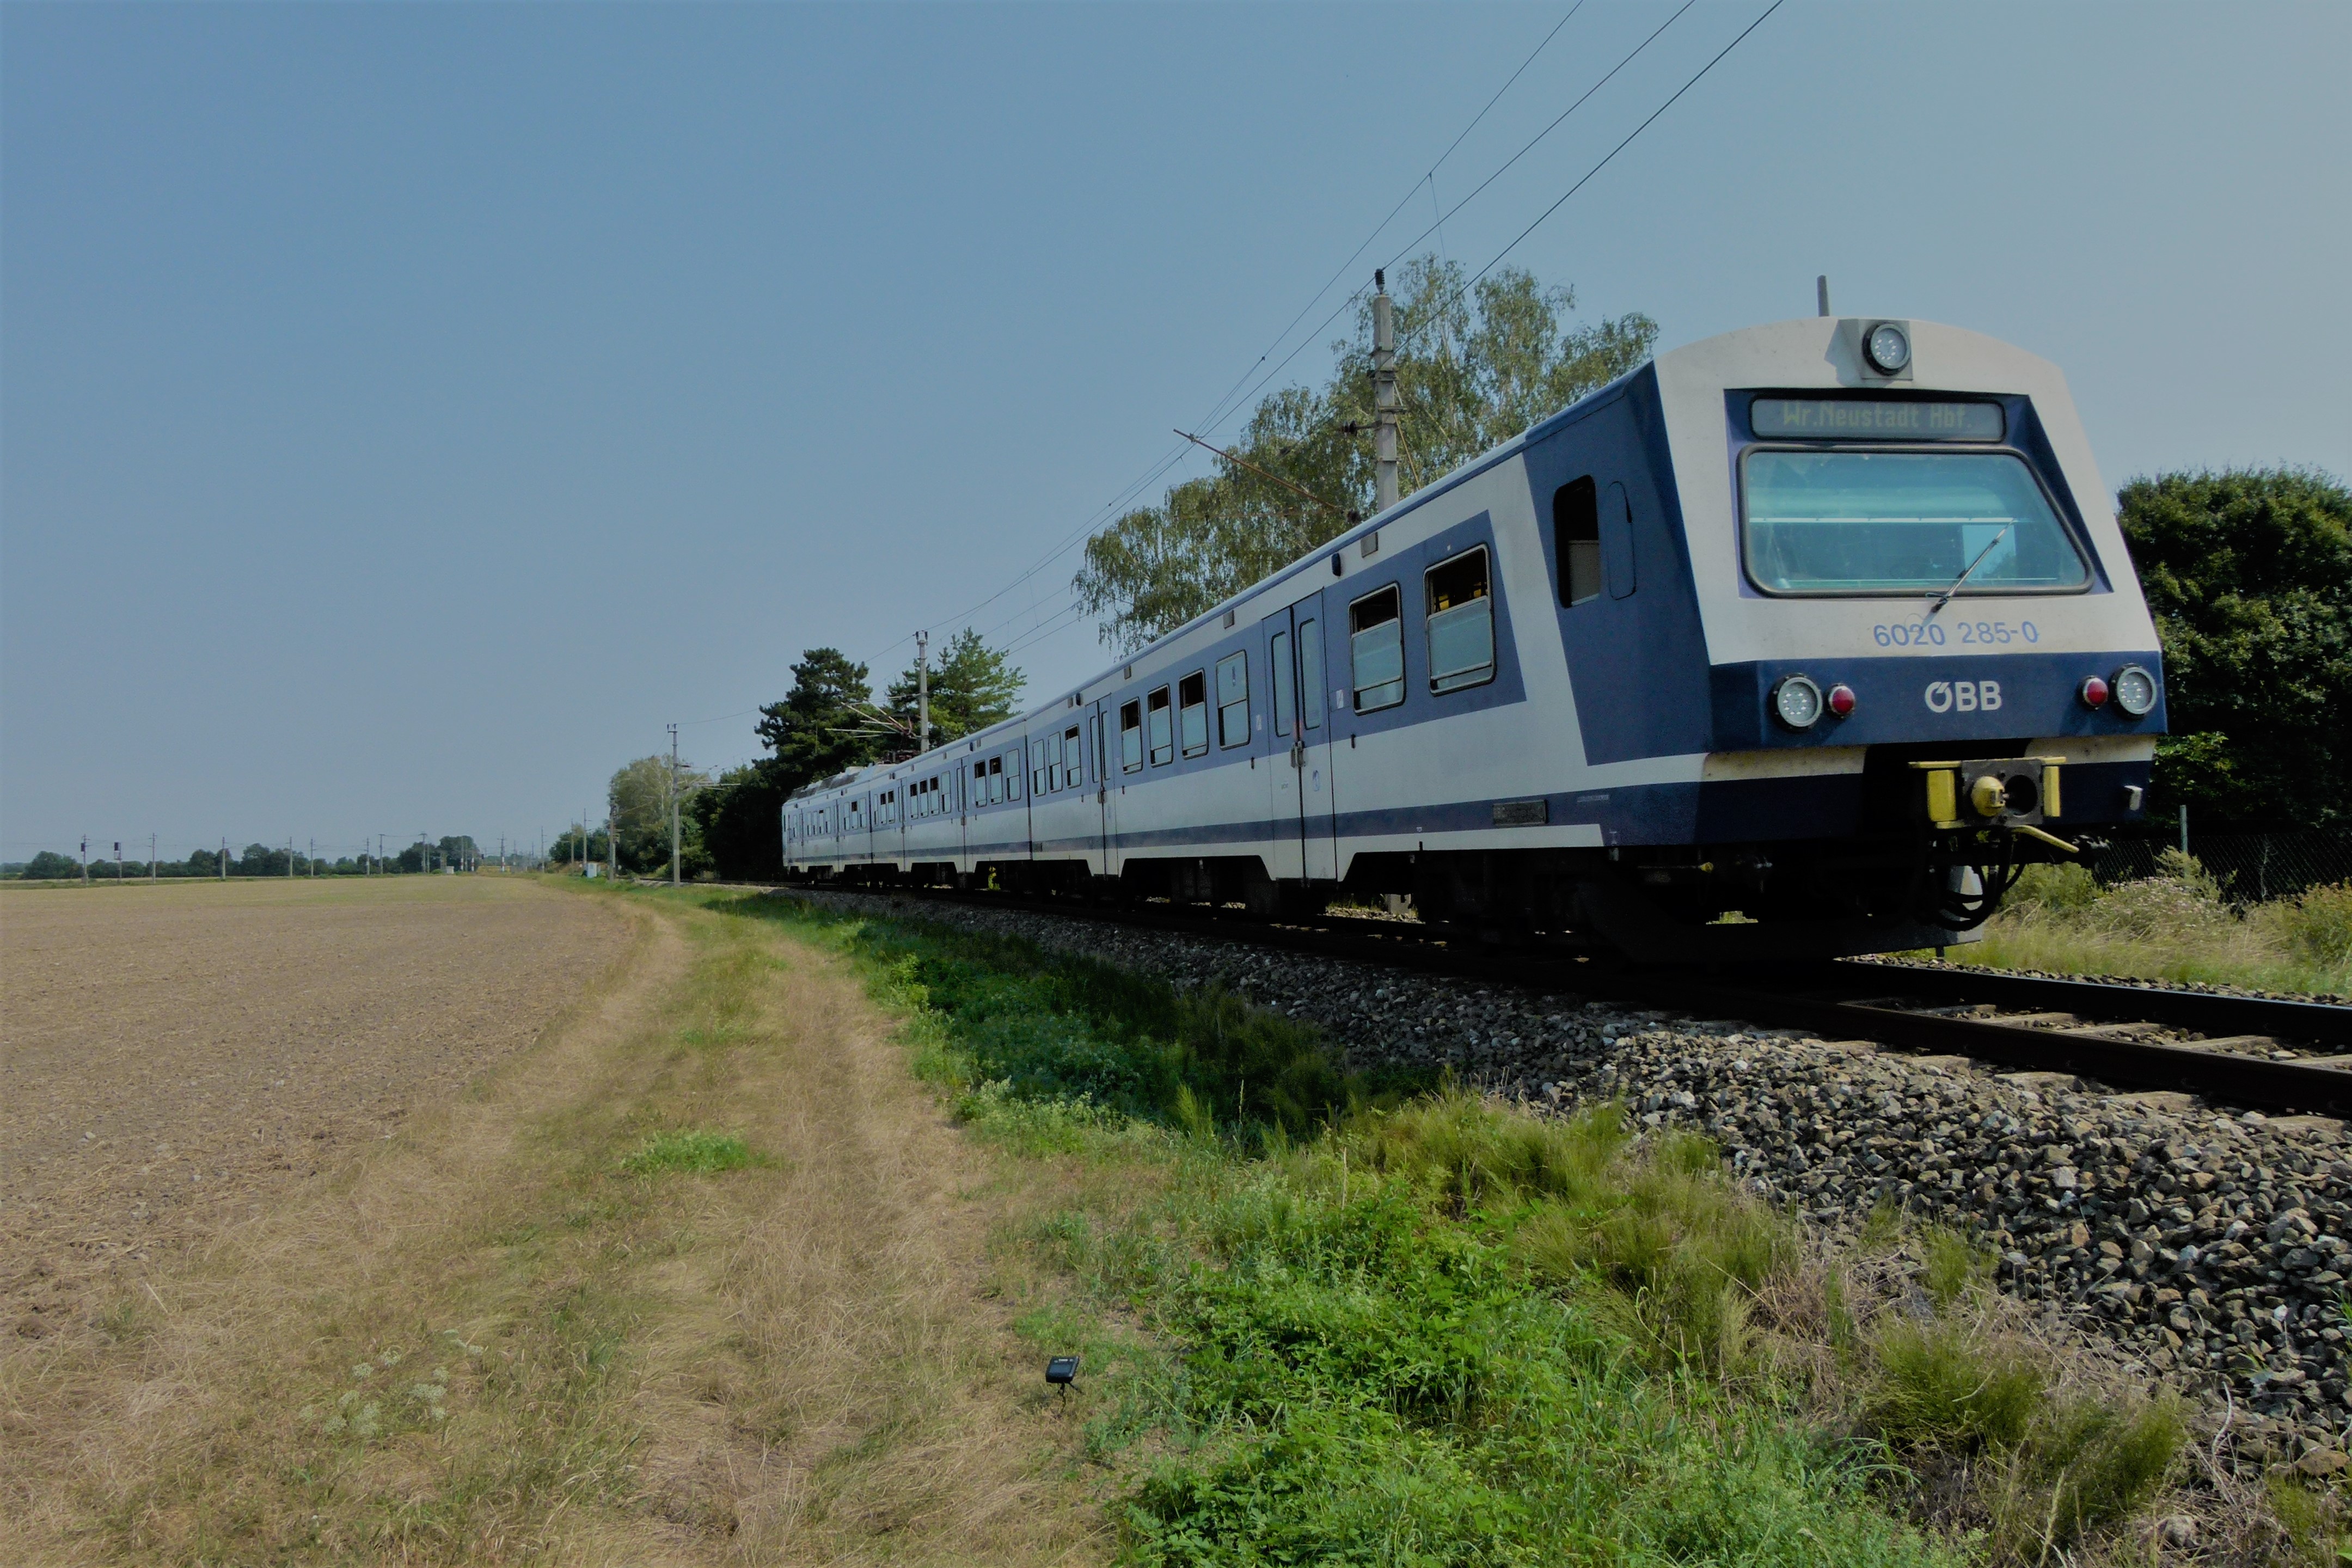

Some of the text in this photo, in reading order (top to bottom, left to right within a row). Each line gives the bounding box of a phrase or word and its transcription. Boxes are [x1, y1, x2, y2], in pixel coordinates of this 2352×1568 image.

[1873, 621, 2039, 647] 6020 285-0
[1925, 681, 2002, 713] ÖBB
